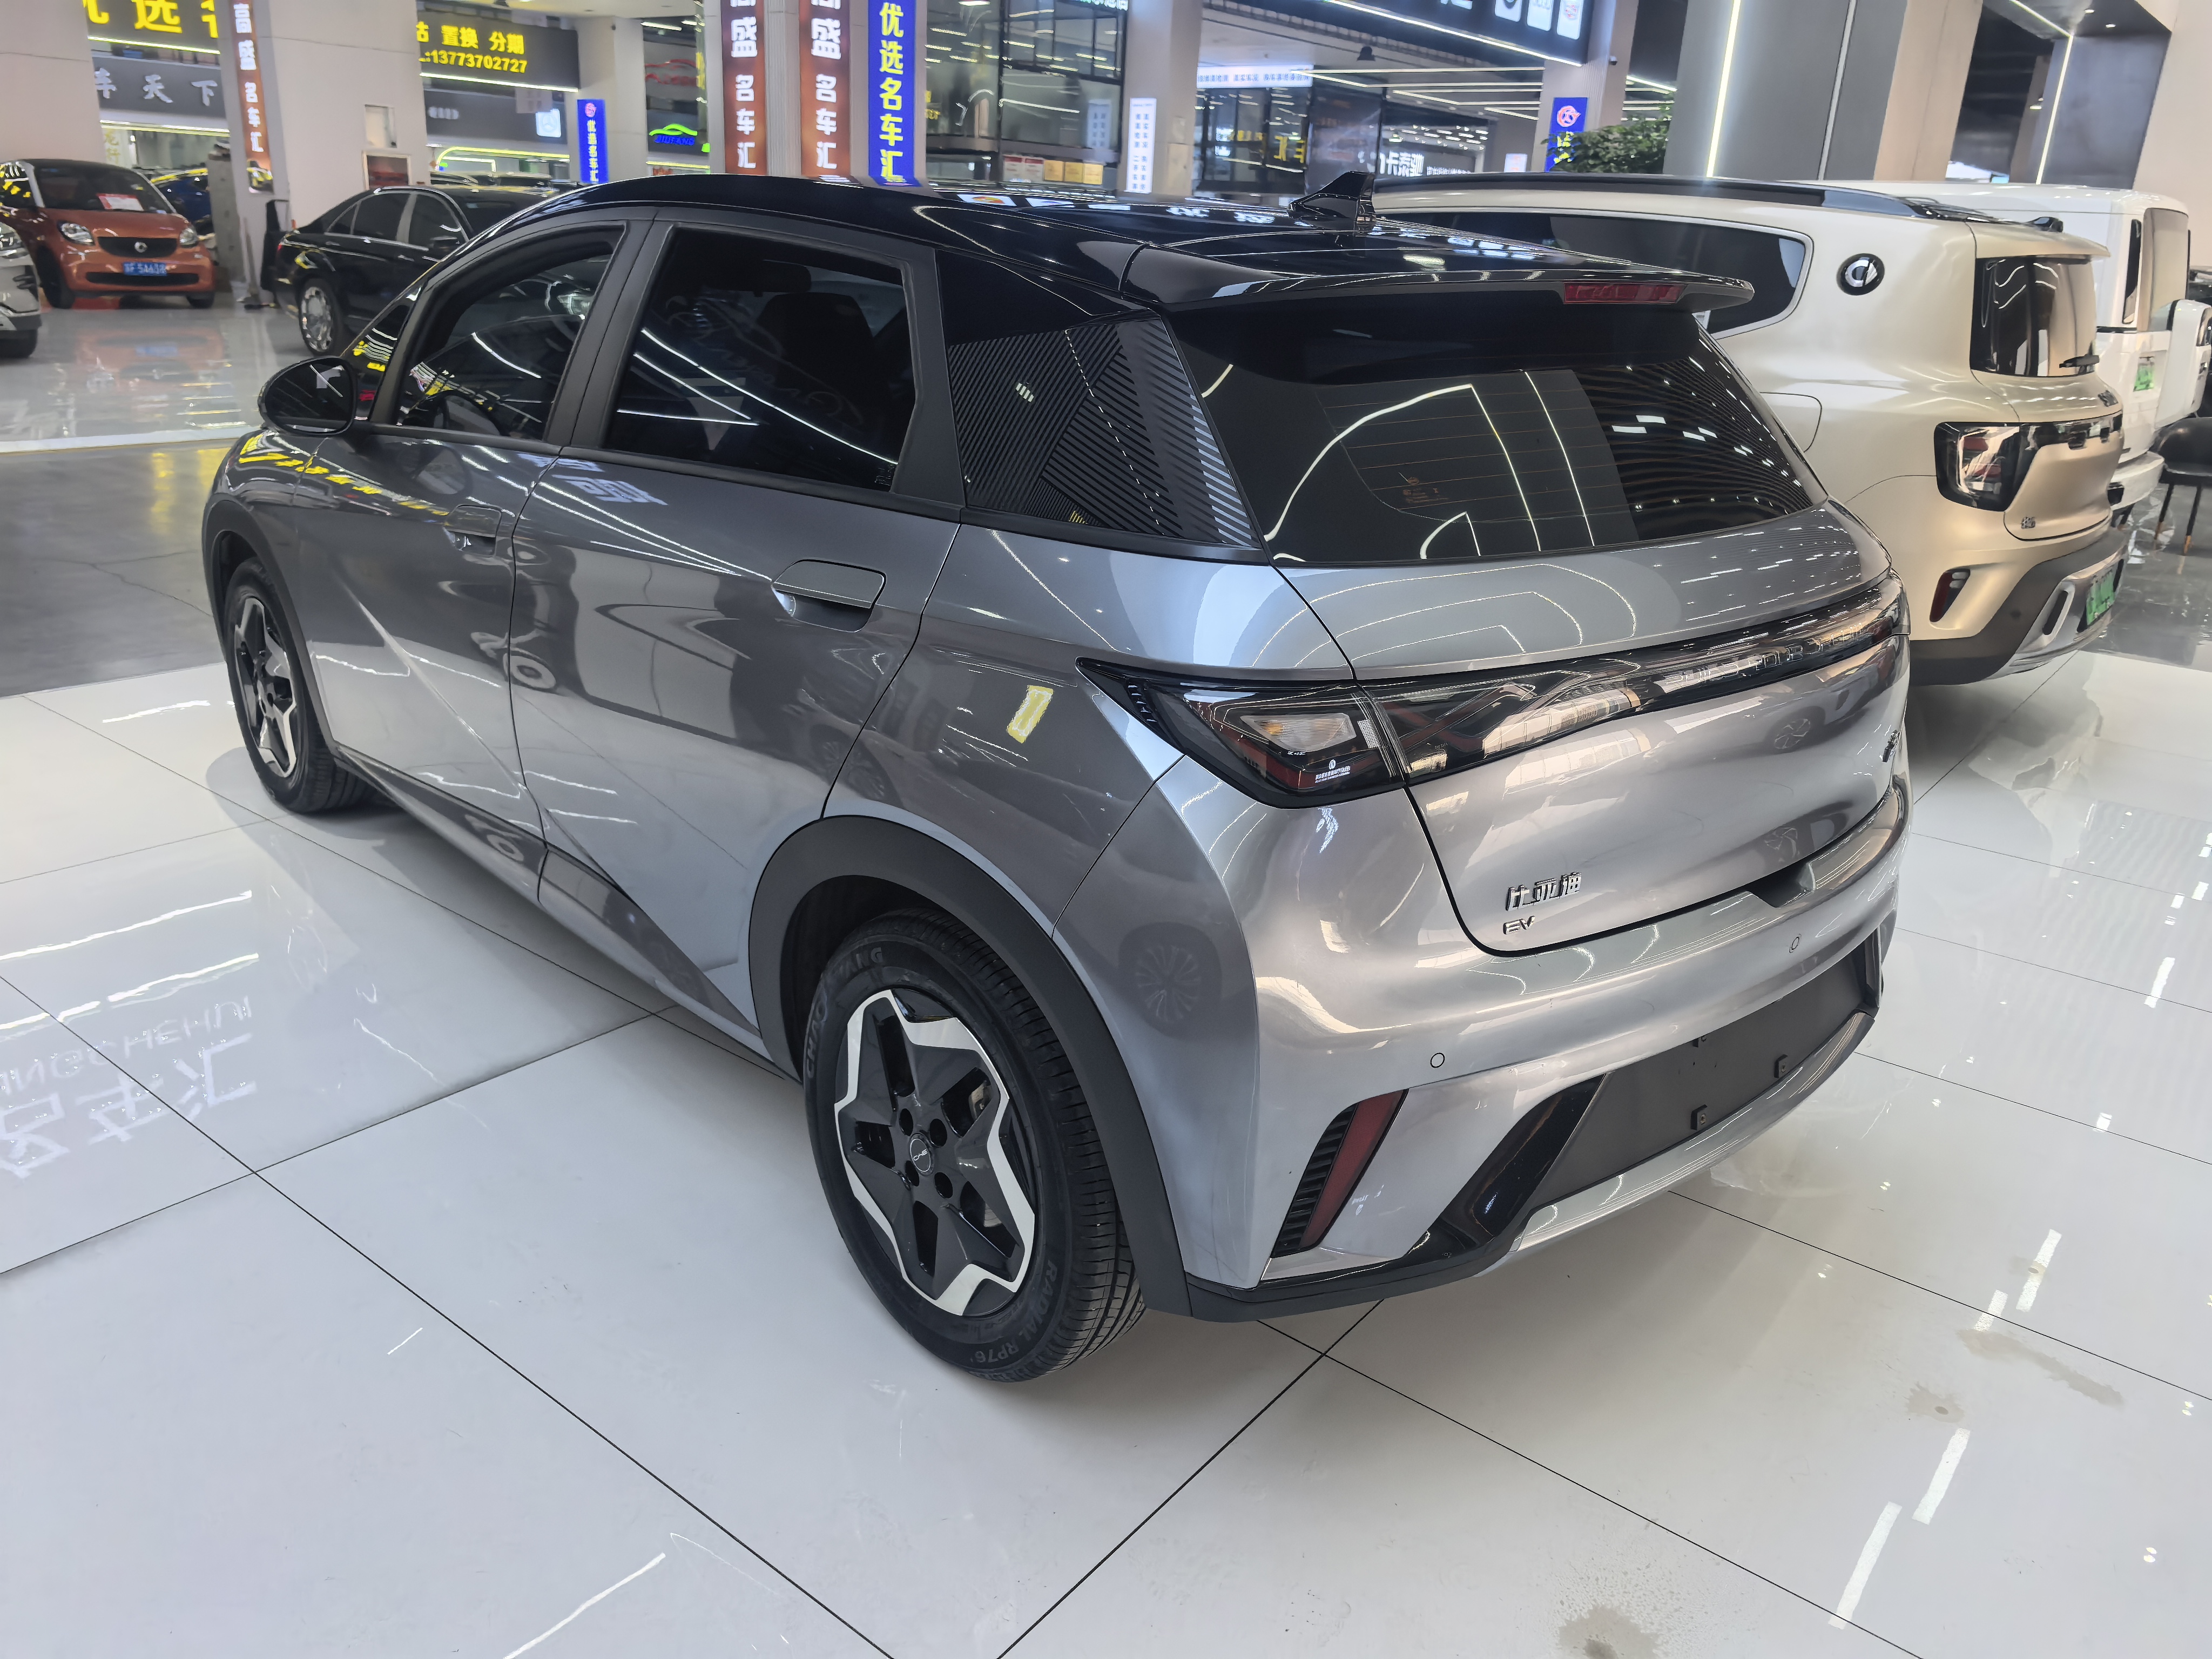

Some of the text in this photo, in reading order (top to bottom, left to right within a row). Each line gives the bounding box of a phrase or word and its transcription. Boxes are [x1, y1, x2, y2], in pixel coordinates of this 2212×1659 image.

[418, 49, 528, 73] :13773702727
[441, 25, 479, 49] 置换
[488, 31, 525, 55] 分期
[730, 0, 757, 169] 盛名车汇
[811, 0, 841, 169] 盛名车汇
[879, 2, 904, 178] 优选名车汇
[1503, 915, 1535, 935] EV
